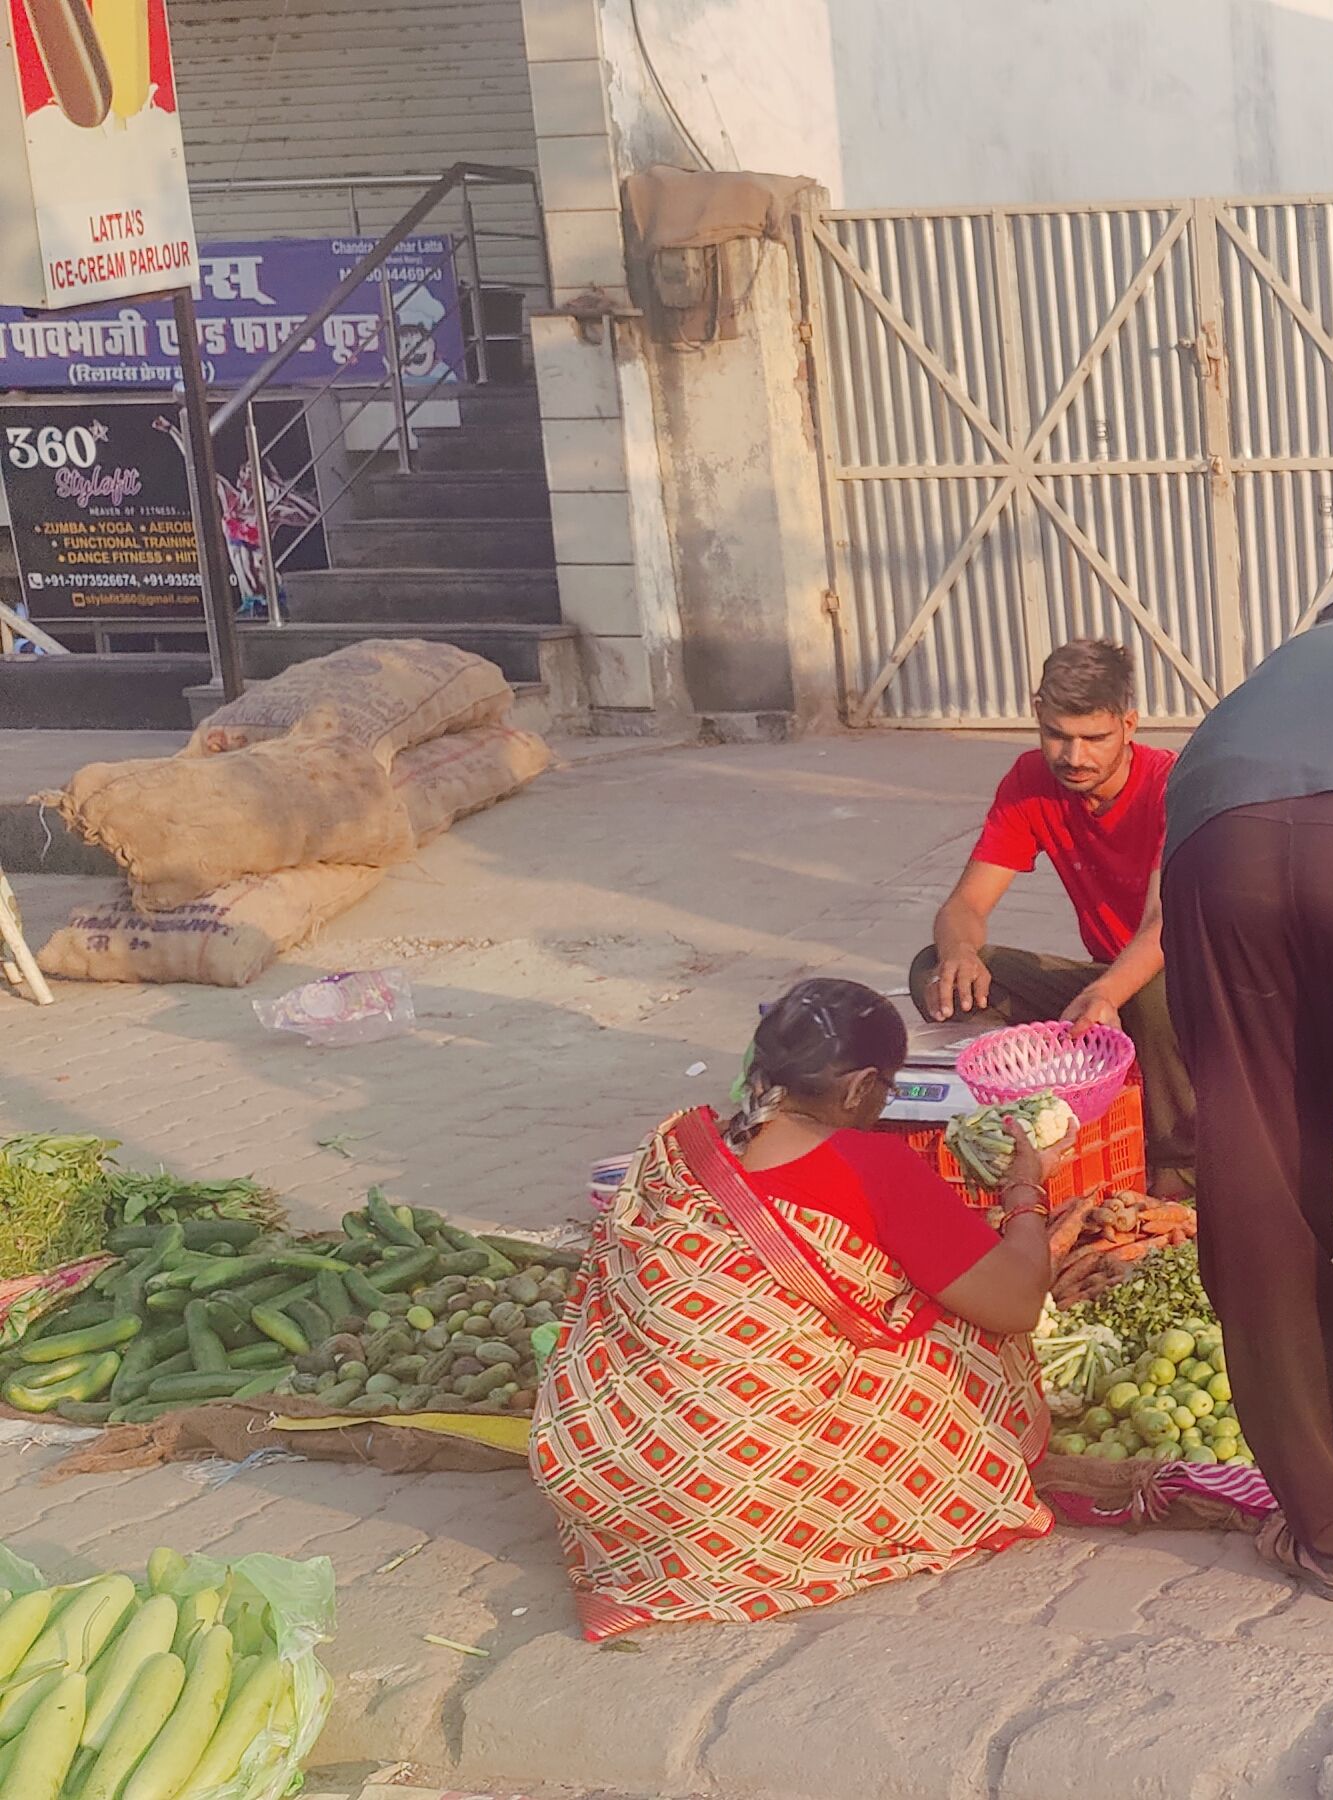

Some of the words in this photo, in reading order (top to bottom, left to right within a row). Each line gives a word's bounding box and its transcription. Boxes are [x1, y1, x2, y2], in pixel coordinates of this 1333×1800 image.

[89, 209, 145, 243] LATTA'S
[417, 239, 444, 253] Latta
[49, 252, 127, 290] ICE-CREAM
[130, 241, 191, 276] PARLOUR
[9, 308, 147, 359] पावभाजी
[322, 314, 380, 364] फूड
[7, 426, 97, 469] 360
[55, 465, 142, 508] Stylefit
[89, 507, 121, 516] HEAVEN
[124, 507, 135, 515] OF
[44, 521, 87, 534] ZUMBA
[97, 521, 134, 534] YOGA
[64, 537, 140, 549] FUNCTIONAL
[67, 552, 110, 564] DANCE
[113, 551, 163, 564] FITNESS
[176, 550, 199, 563] HIIT
